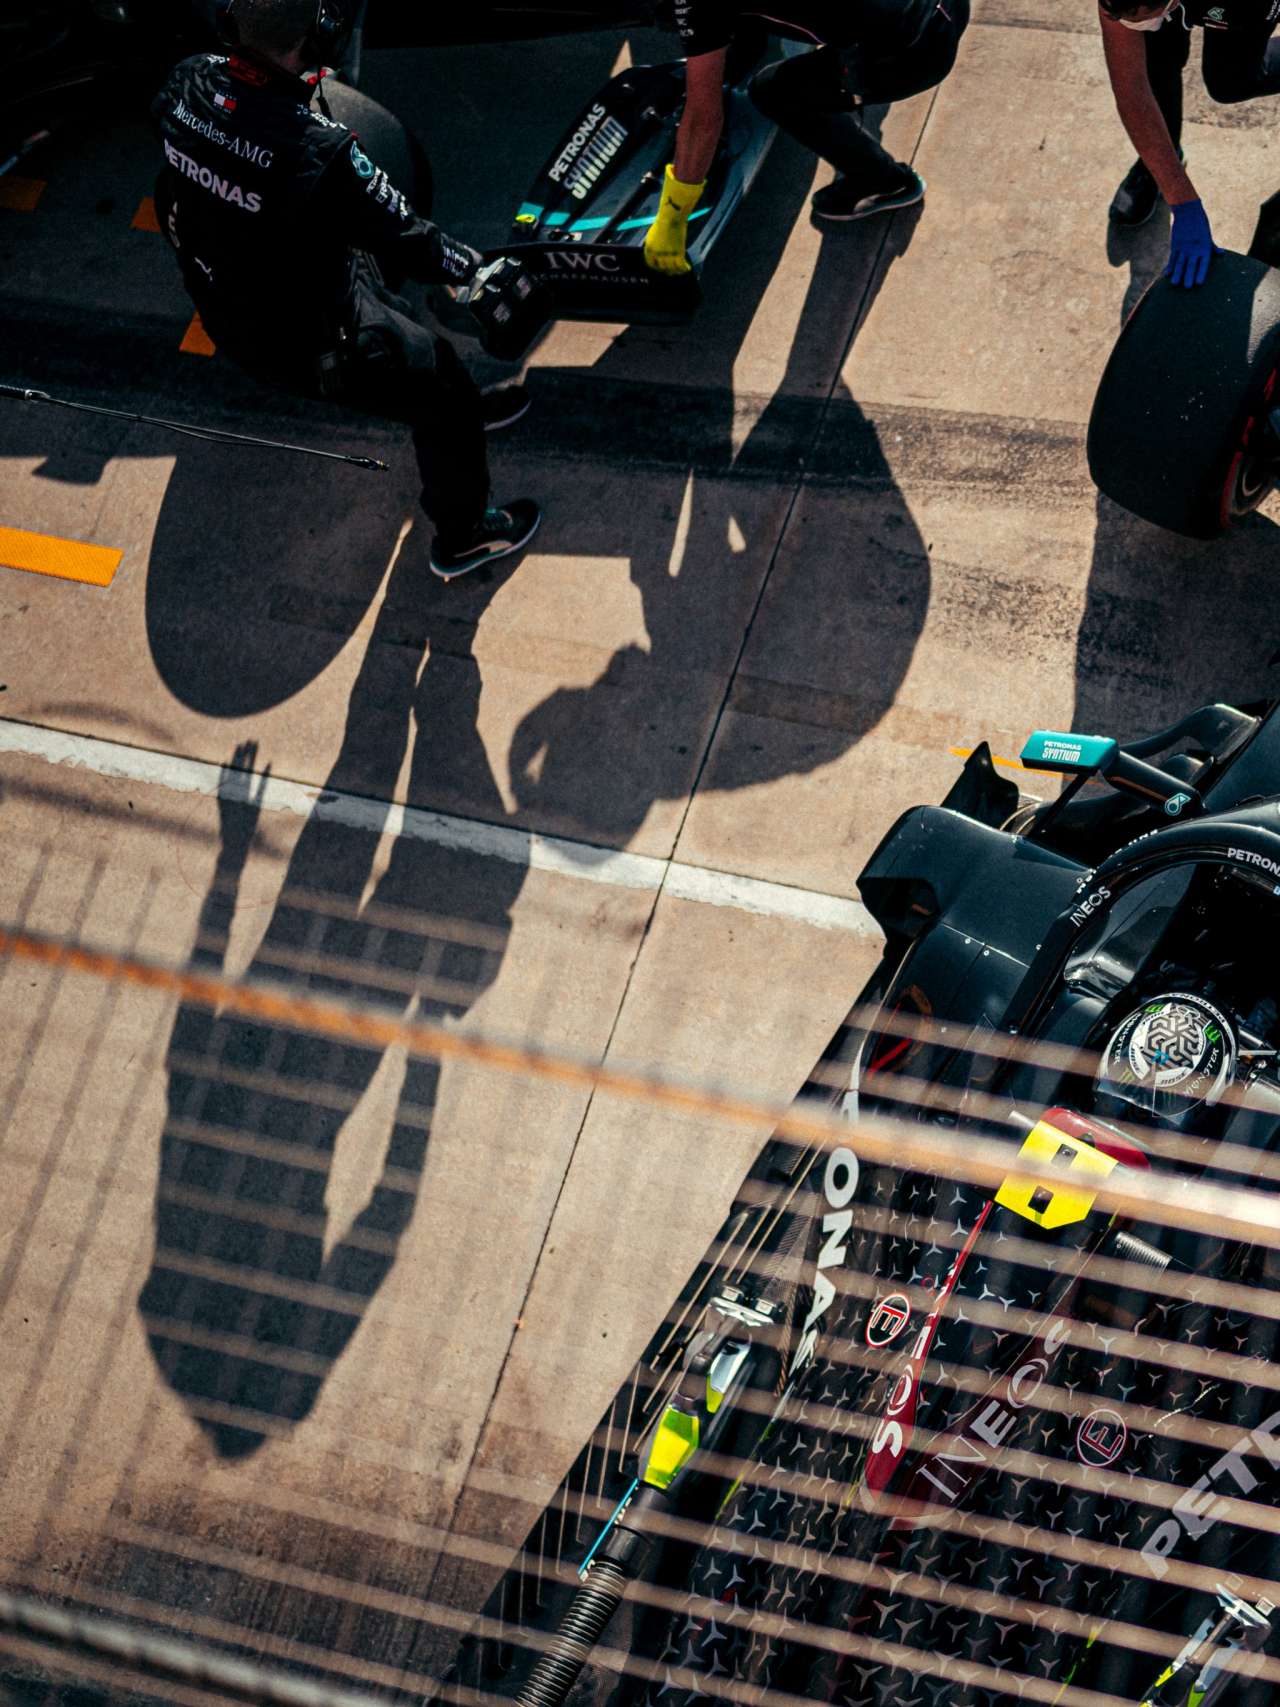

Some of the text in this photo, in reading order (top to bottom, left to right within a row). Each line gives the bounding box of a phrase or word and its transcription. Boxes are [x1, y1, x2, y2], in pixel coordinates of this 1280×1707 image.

[173, 99, 274, 168] Mercedes-AMG
[549, 102, 606, 183] PETRONAS
[562, 115, 629, 200] SYNTIUM
[545, 251, 621, 272] IWC
[1042, 747, 1081, 762] SYNTIUM
[1043, 740, 1082, 751] PETRONAS
[1069, 885, 1112, 928] INEOS
